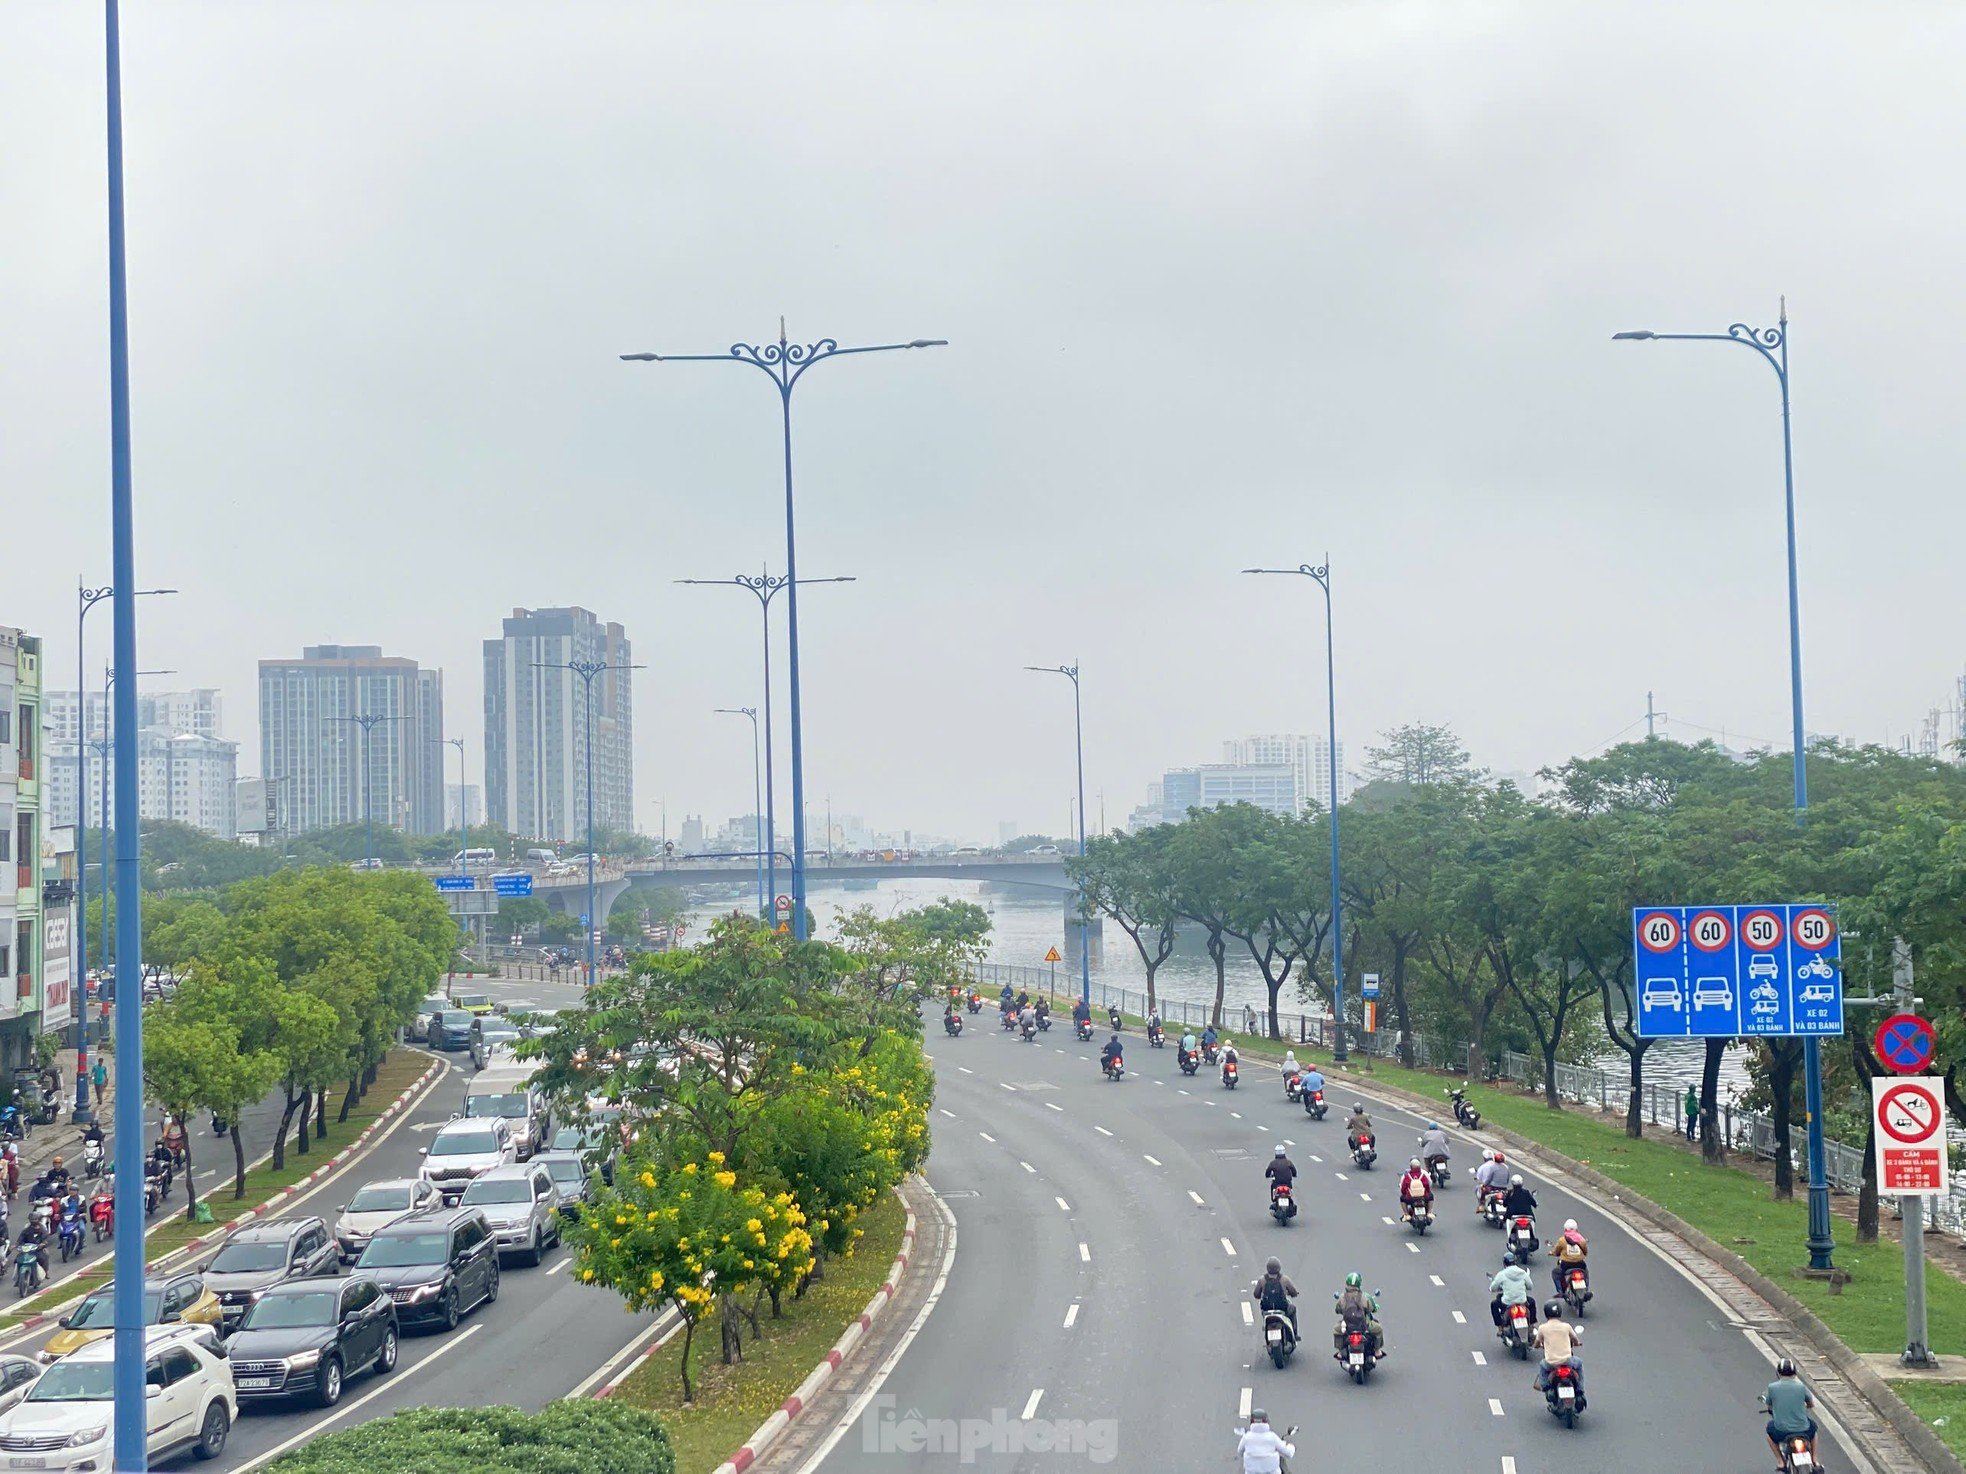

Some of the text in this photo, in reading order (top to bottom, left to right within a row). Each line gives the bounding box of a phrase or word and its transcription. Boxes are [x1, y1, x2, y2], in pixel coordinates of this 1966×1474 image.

[1650, 922, 1670, 942] 60
[1701, 921, 1721, 941] 60
[1752, 921, 1772, 940] 50
[1803, 920, 1824, 939] 50
[1807, 1009, 1828, 1017] XE 02
[1795, 1020, 1840, 1030] VÀ 03 BÁNH
